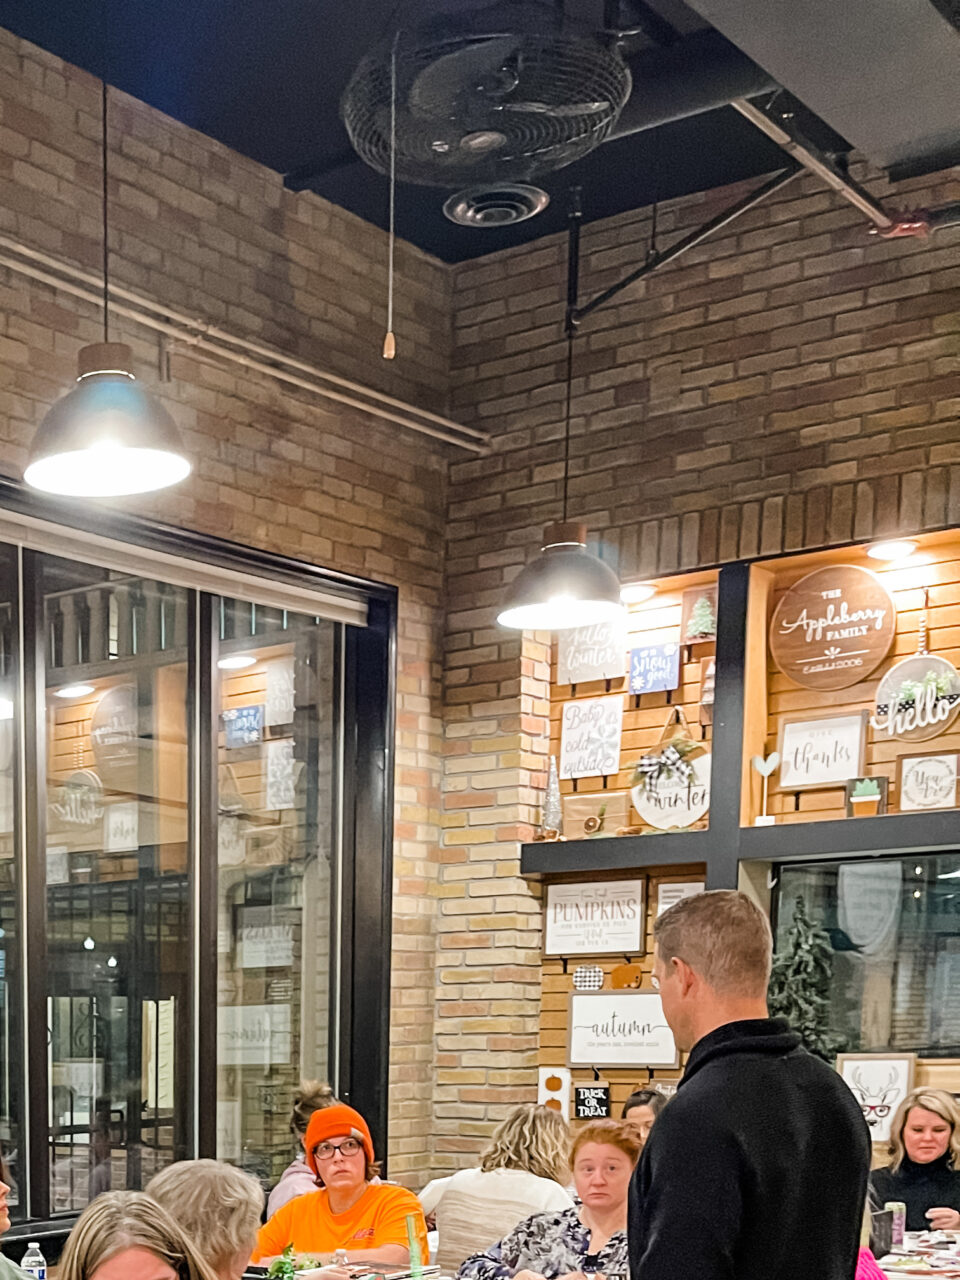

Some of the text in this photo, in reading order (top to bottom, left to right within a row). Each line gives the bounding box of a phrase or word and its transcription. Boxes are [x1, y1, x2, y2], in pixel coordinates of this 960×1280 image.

[821, 588, 842, 600] THE
[779, 602, 886, 642] Appleberry
[826, 625, 869, 641] FAMILY
[870, 683, 960, 736] hello
[794, 740, 852, 774] thanks
[553, 898, 637, 924] PUMPKINS
[574, 1011, 670, 1038] autumn
[578, 1088, 607, 1100] TRICK
[585, 1099, 600, 1108] OR
[578, 1107, 608, 1117] TREAT
